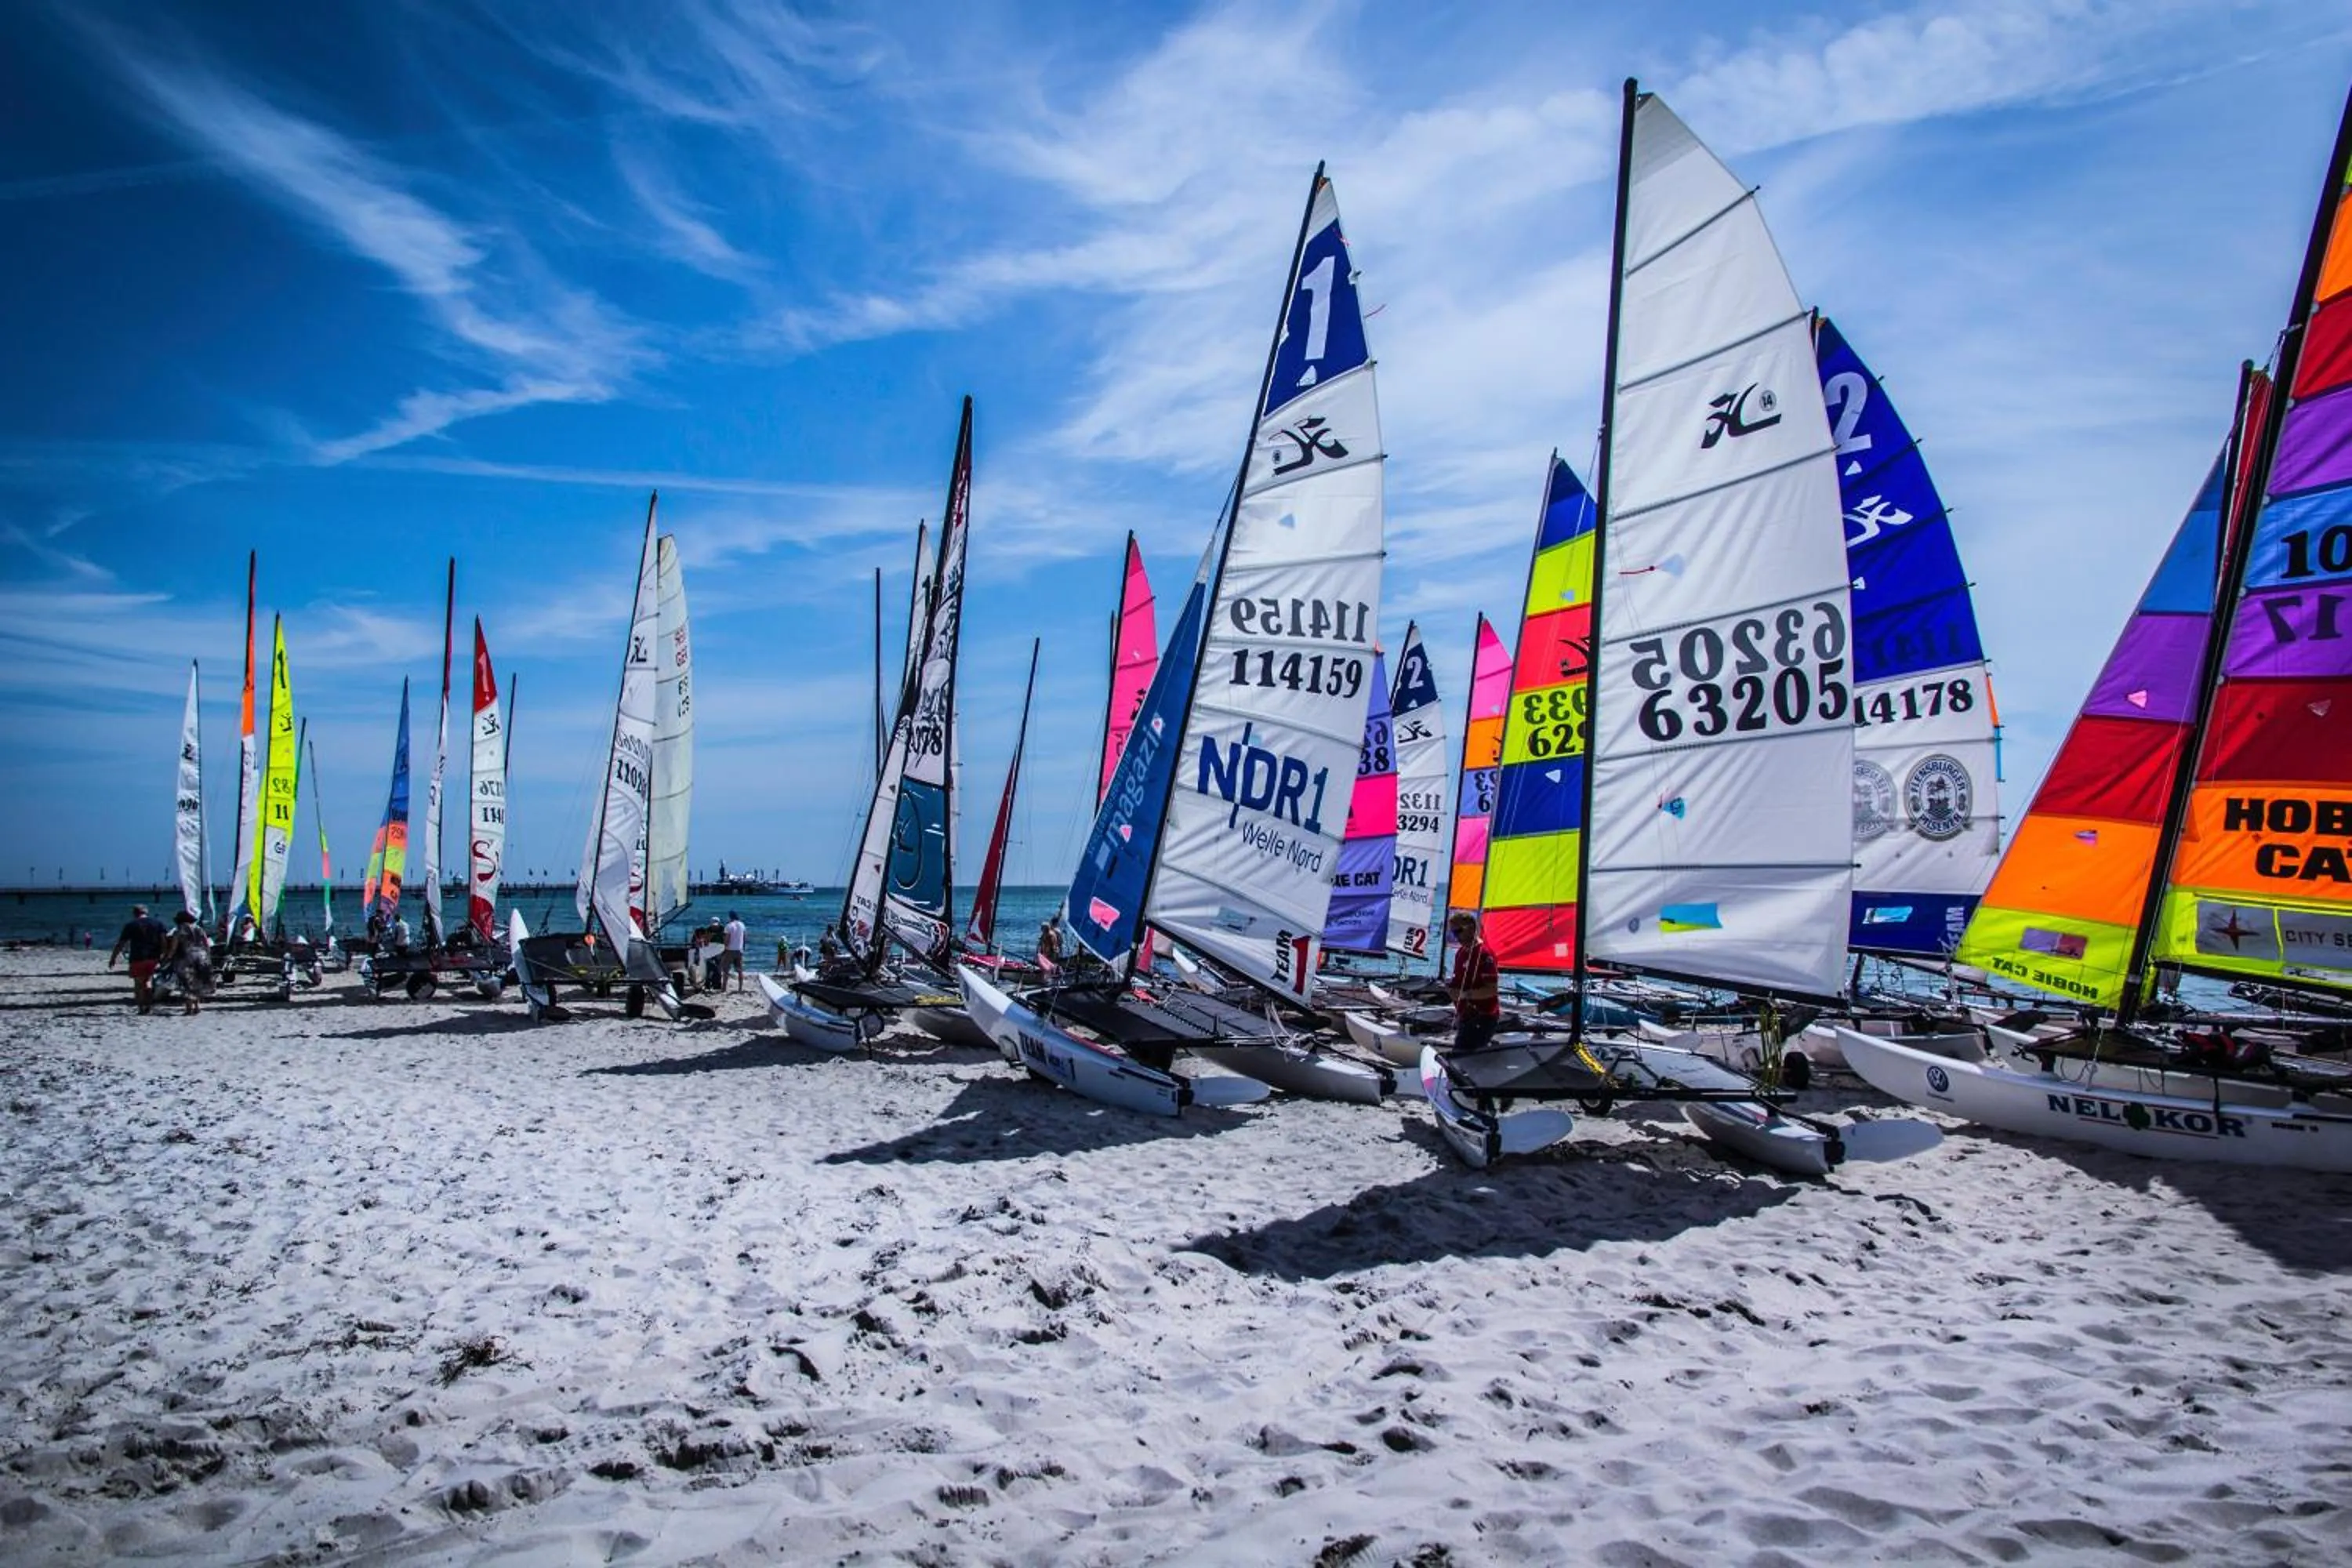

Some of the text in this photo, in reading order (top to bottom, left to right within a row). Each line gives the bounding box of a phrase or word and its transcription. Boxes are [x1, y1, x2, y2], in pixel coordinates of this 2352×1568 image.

[1301, 255, 1335, 360] 1
[1825, 371, 1872, 456] 2
[2281, 524, 2352, 579] 10
[1229, 649, 1363, 698] 114159
[1408, 655, 1425, 689] 2
[1639, 659, 1848, 742] 63205
[1854, 679, 1973, 728] 14178
[1106, 720, 1162, 848] magazi
[1397, 814, 1439, 834] 3294
[2223, 798, 2352, 837] HOB
[1243, 821, 1323, 873] Welle Nord
[2256, 844, 2352, 883] CA
[1354, 871, 1380, 887] CAT
[1413, 928, 1426, 954] 2
[2285, 930, 2326, 943] CITY
[1271, 930, 1312, 996] TEAM 1
